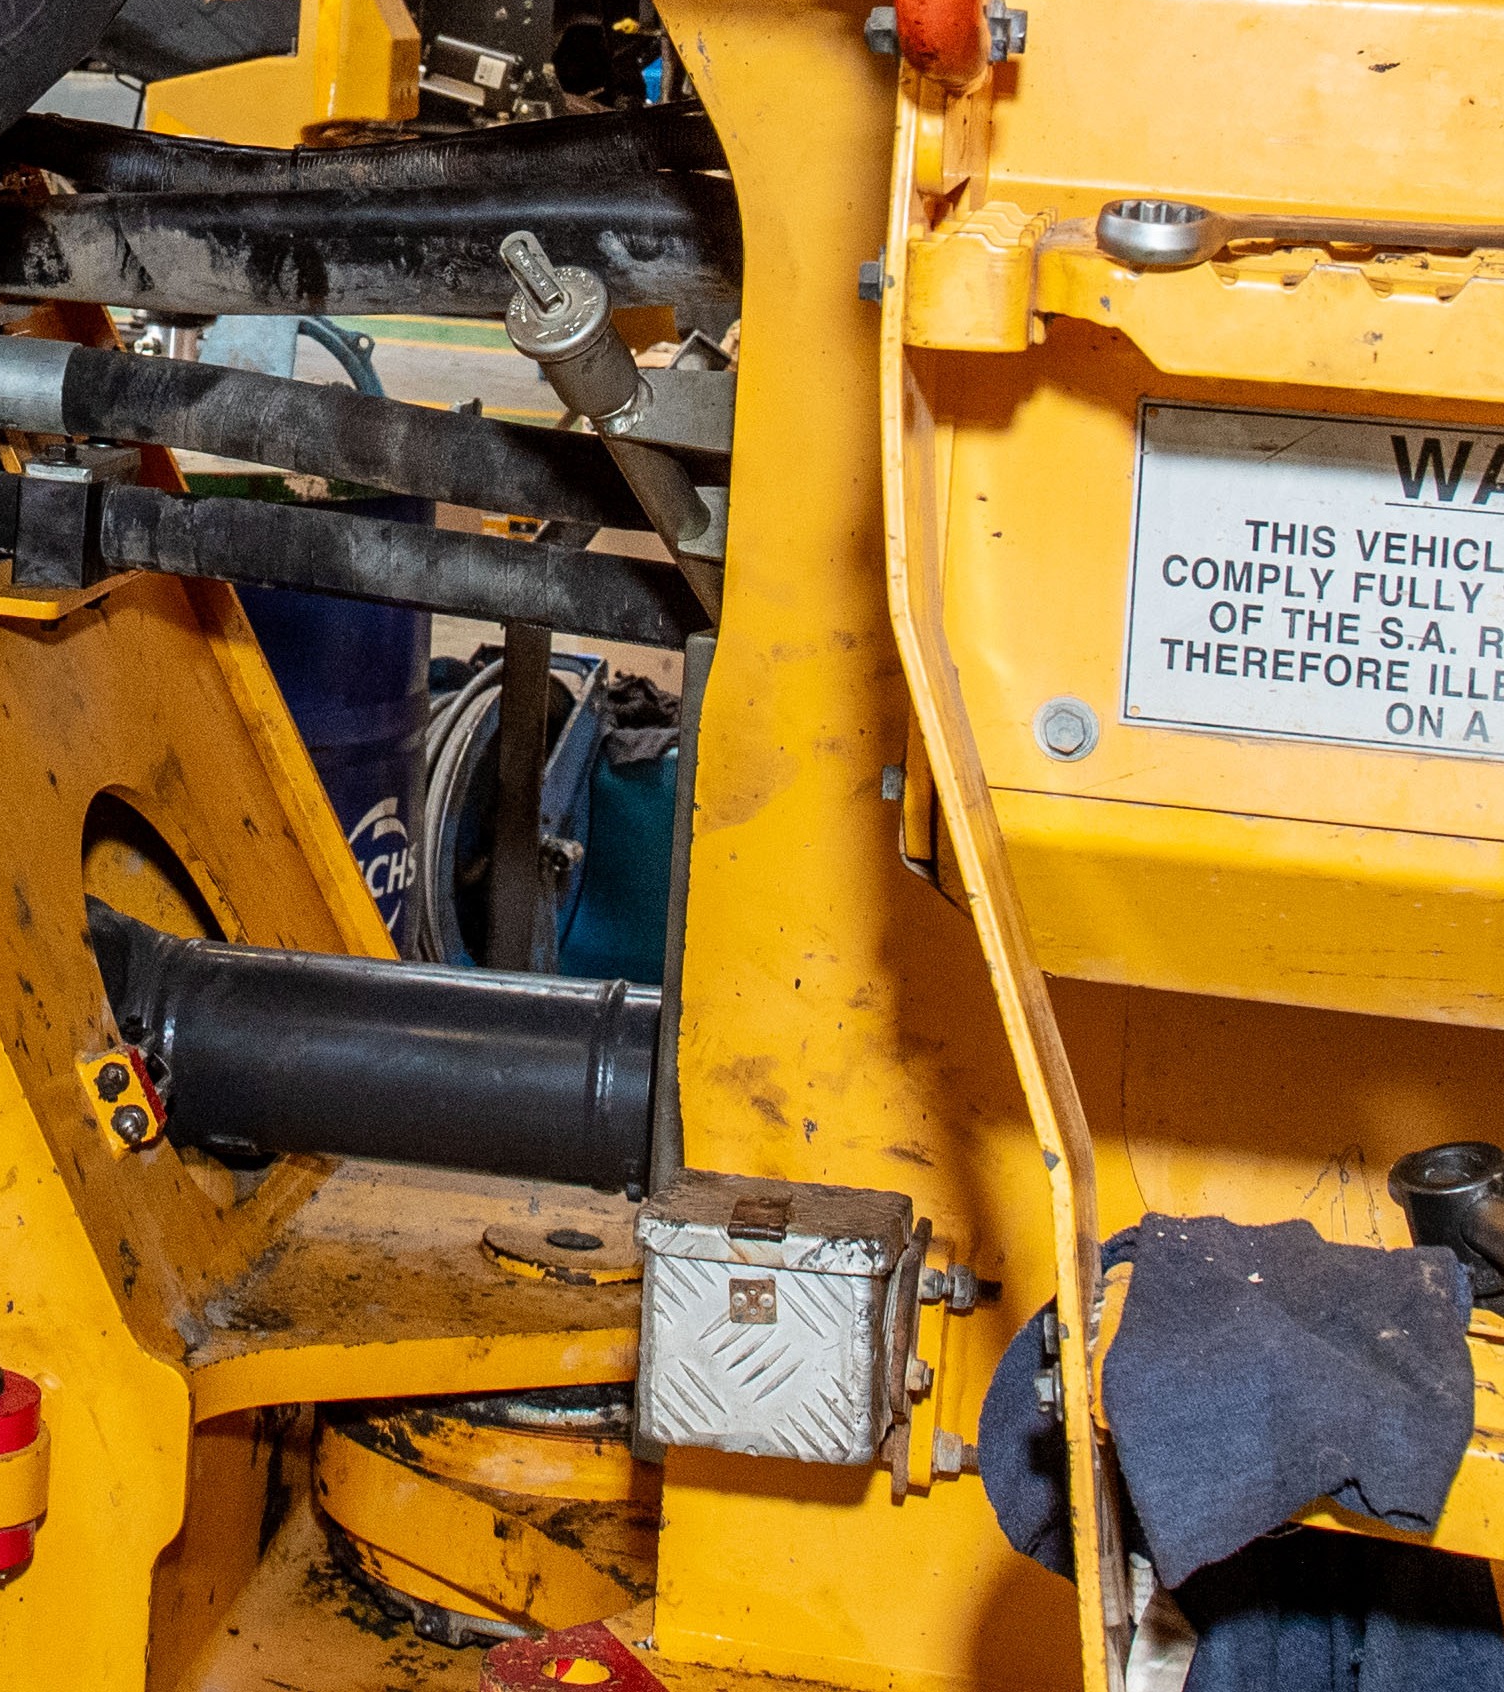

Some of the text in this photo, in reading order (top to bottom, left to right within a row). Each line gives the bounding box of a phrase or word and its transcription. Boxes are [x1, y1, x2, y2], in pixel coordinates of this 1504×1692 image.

[1244, 518, 1336, 559] THIS
[1162, 553, 1336, 604] COMPLY
[1352, 571, 1485, 615] FULLY
[1208, 600, 1265, 636] OF
[1280, 606, 1361, 646] THE
[1379, 616, 1457, 656] S.A.
[1159, 637, 1410, 694] THEREFORE
[1385, 701, 1445, 739] ON
[1462, 709, 1490, 744] A
[358, 842, 417, 898] CHS
